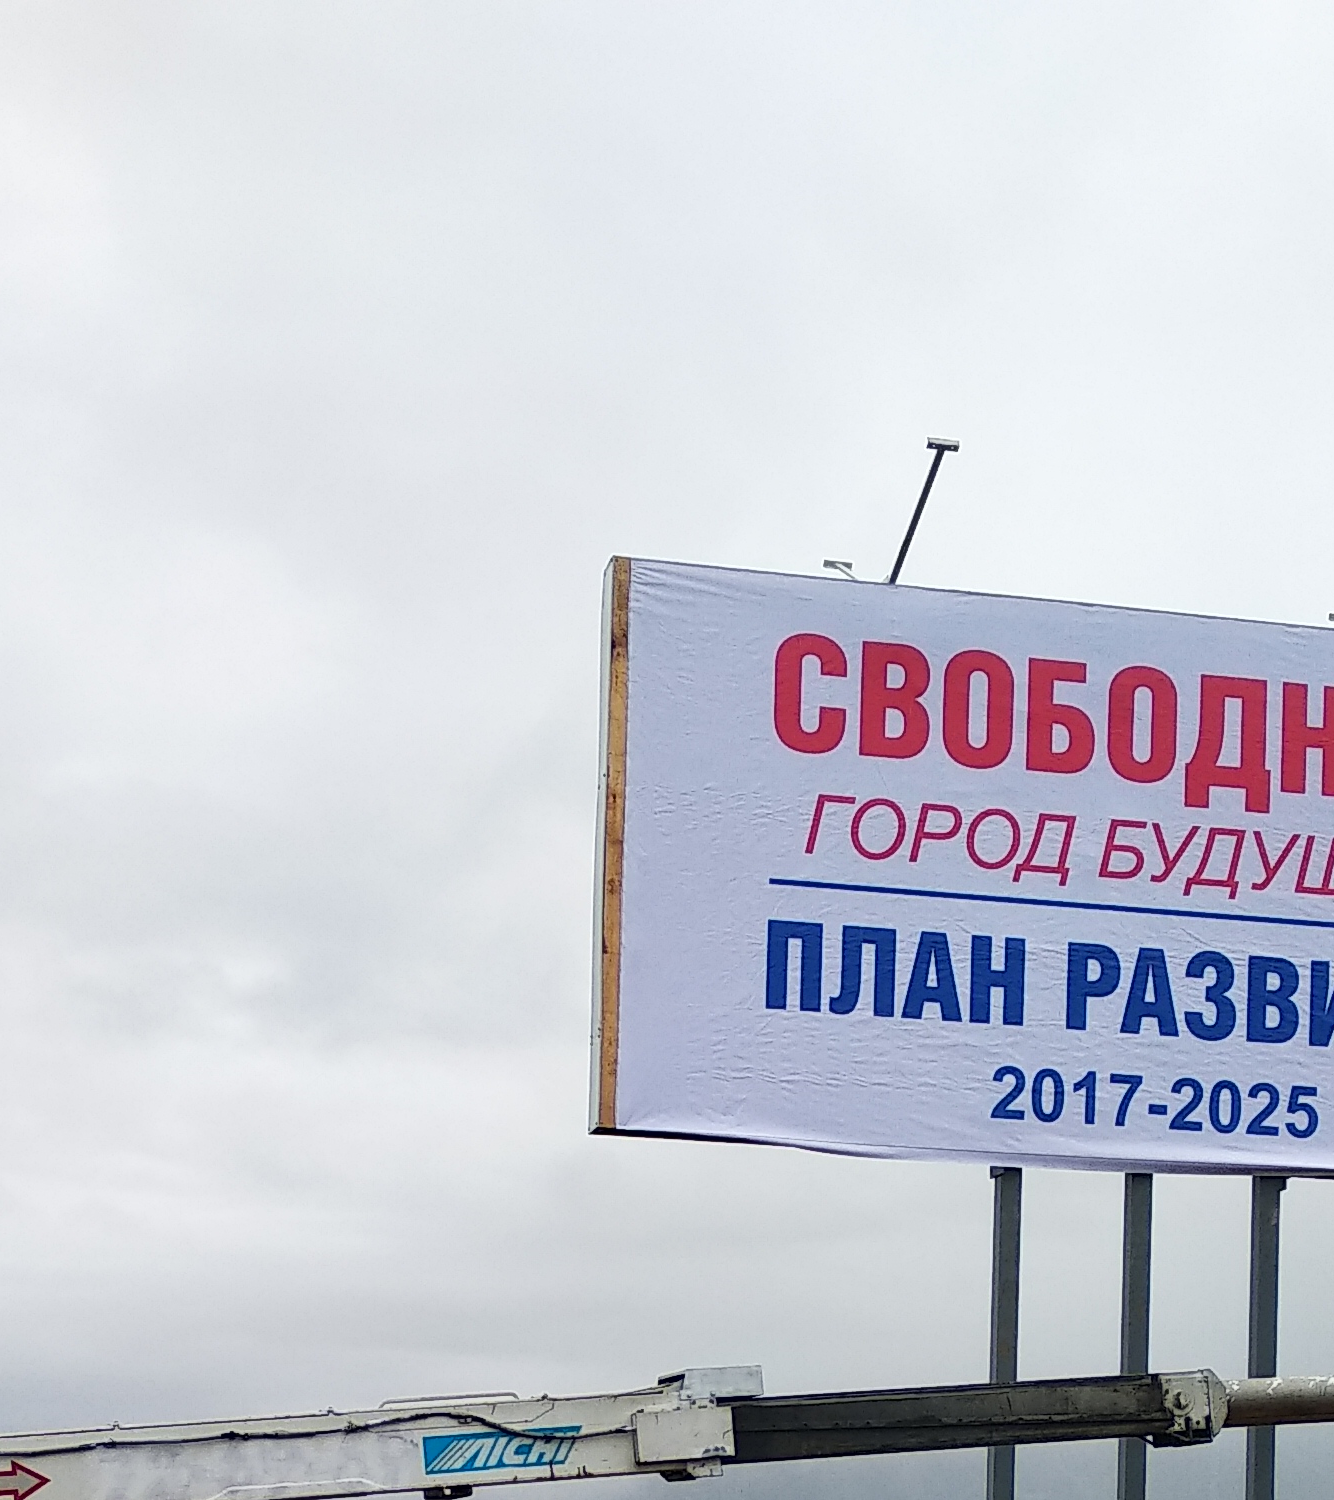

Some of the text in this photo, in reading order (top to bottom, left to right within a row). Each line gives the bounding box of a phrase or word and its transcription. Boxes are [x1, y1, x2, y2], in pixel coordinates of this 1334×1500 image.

[804, 794, 1076, 887] ГОРОД
[764, 919, 1027, 1028] ПЛАН
[989, 1063, 1321, 1140] 2017-2025
[427, 1430, 580, 1472] AICHI
